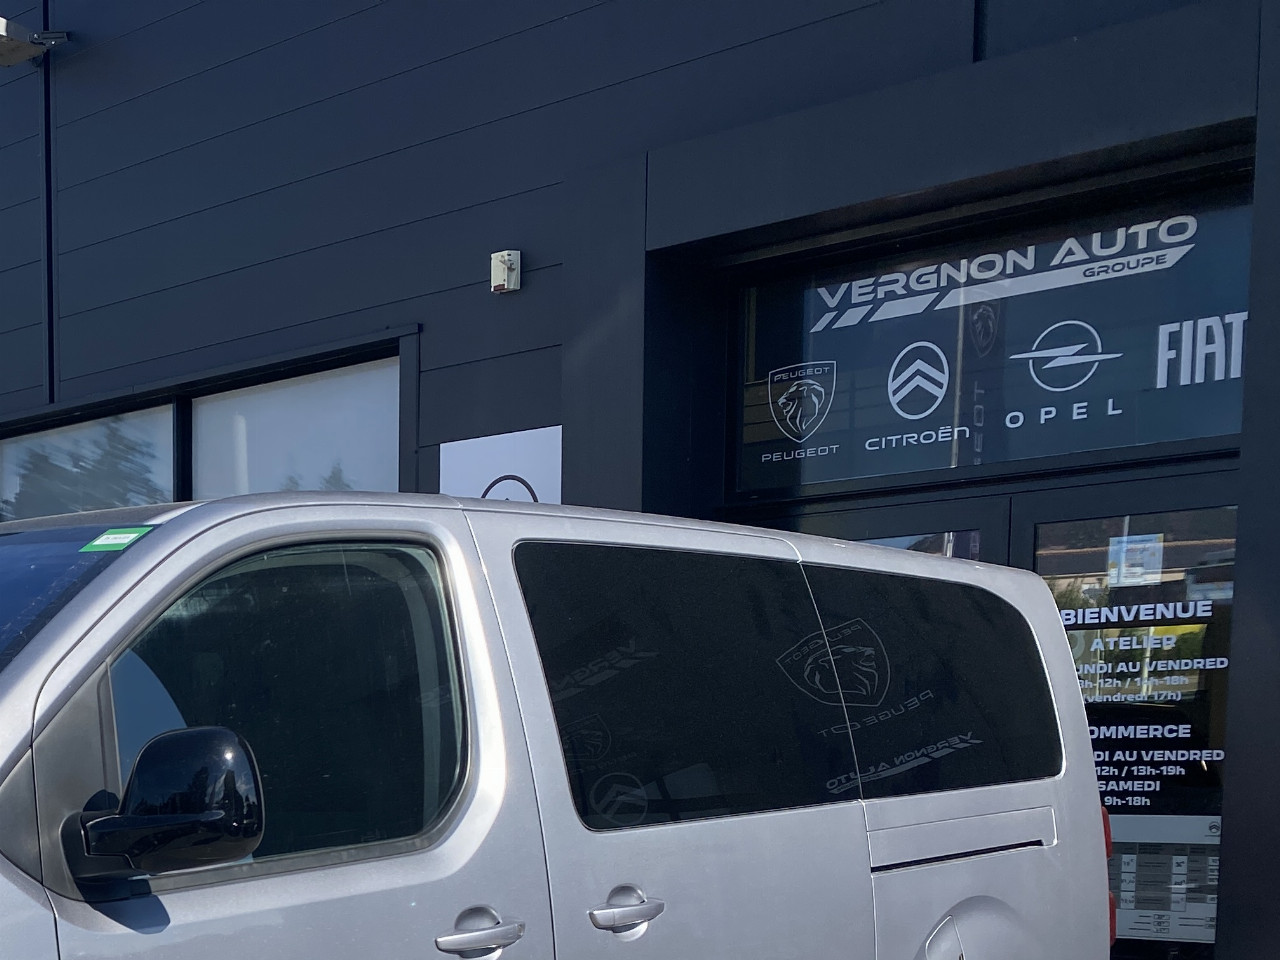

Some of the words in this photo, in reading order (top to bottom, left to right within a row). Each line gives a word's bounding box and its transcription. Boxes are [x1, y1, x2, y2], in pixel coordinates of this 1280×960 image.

[817, 245, 1035, 308] VERGNON
[1049, 214, 1198, 266] AUTO
[1082, 252, 1168, 279] GROUPE
[1156, 311, 1249, 390] FIAT
[773, 366, 831, 383] PEUGEOT
[1005, 398, 1123, 429] OPEL
[761, 444, 840, 463] PEUGEOT
[1060, 600, 1213, 626] BIENVENUE
[1090, 635, 1177, 652] ATELIER
[1116, 661, 1141, 673] AU
[1145, 657, 1229, 671] VENDRED
[1152, 690, 1182, 702] 17h)
[1089, 724, 1192, 739] OMMERCE
[1112, 750, 1138, 762] AU
[1141, 749, 1226, 762] VENDRED
[1121, 766, 1129, 777] /
[1130, 765, 1186, 776] 13h-19h
[1097, 780, 1161, 792] SAMEDI
[1104, 796, 1151, 806] 9h-18h
